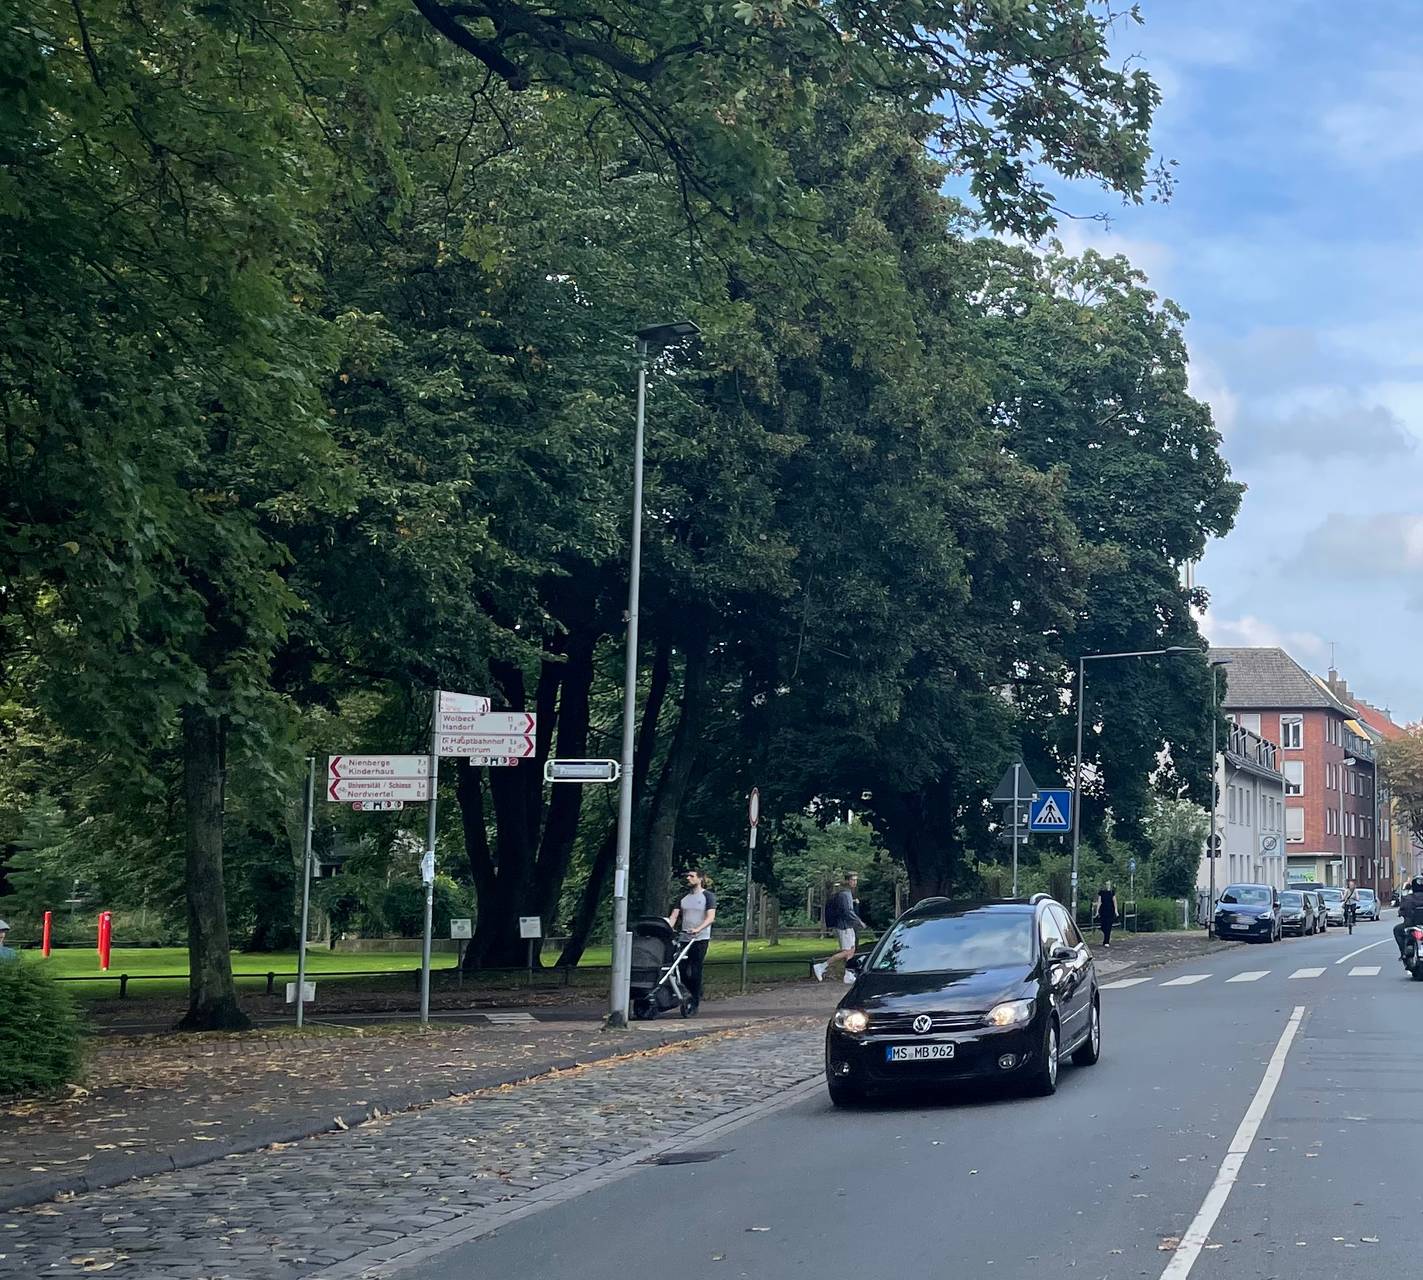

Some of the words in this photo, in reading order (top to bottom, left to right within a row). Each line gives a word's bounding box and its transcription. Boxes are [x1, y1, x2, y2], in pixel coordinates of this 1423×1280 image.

[450, 738, 505, 746] Hauptbahnhof
[348, 759, 390, 767] Nienberge
[348, 781, 381, 789] Universität
[893, 1047, 908, 1059] MS
[914, 1046, 930, 1059] MB
[932, 1045, 953, 1057] 962
